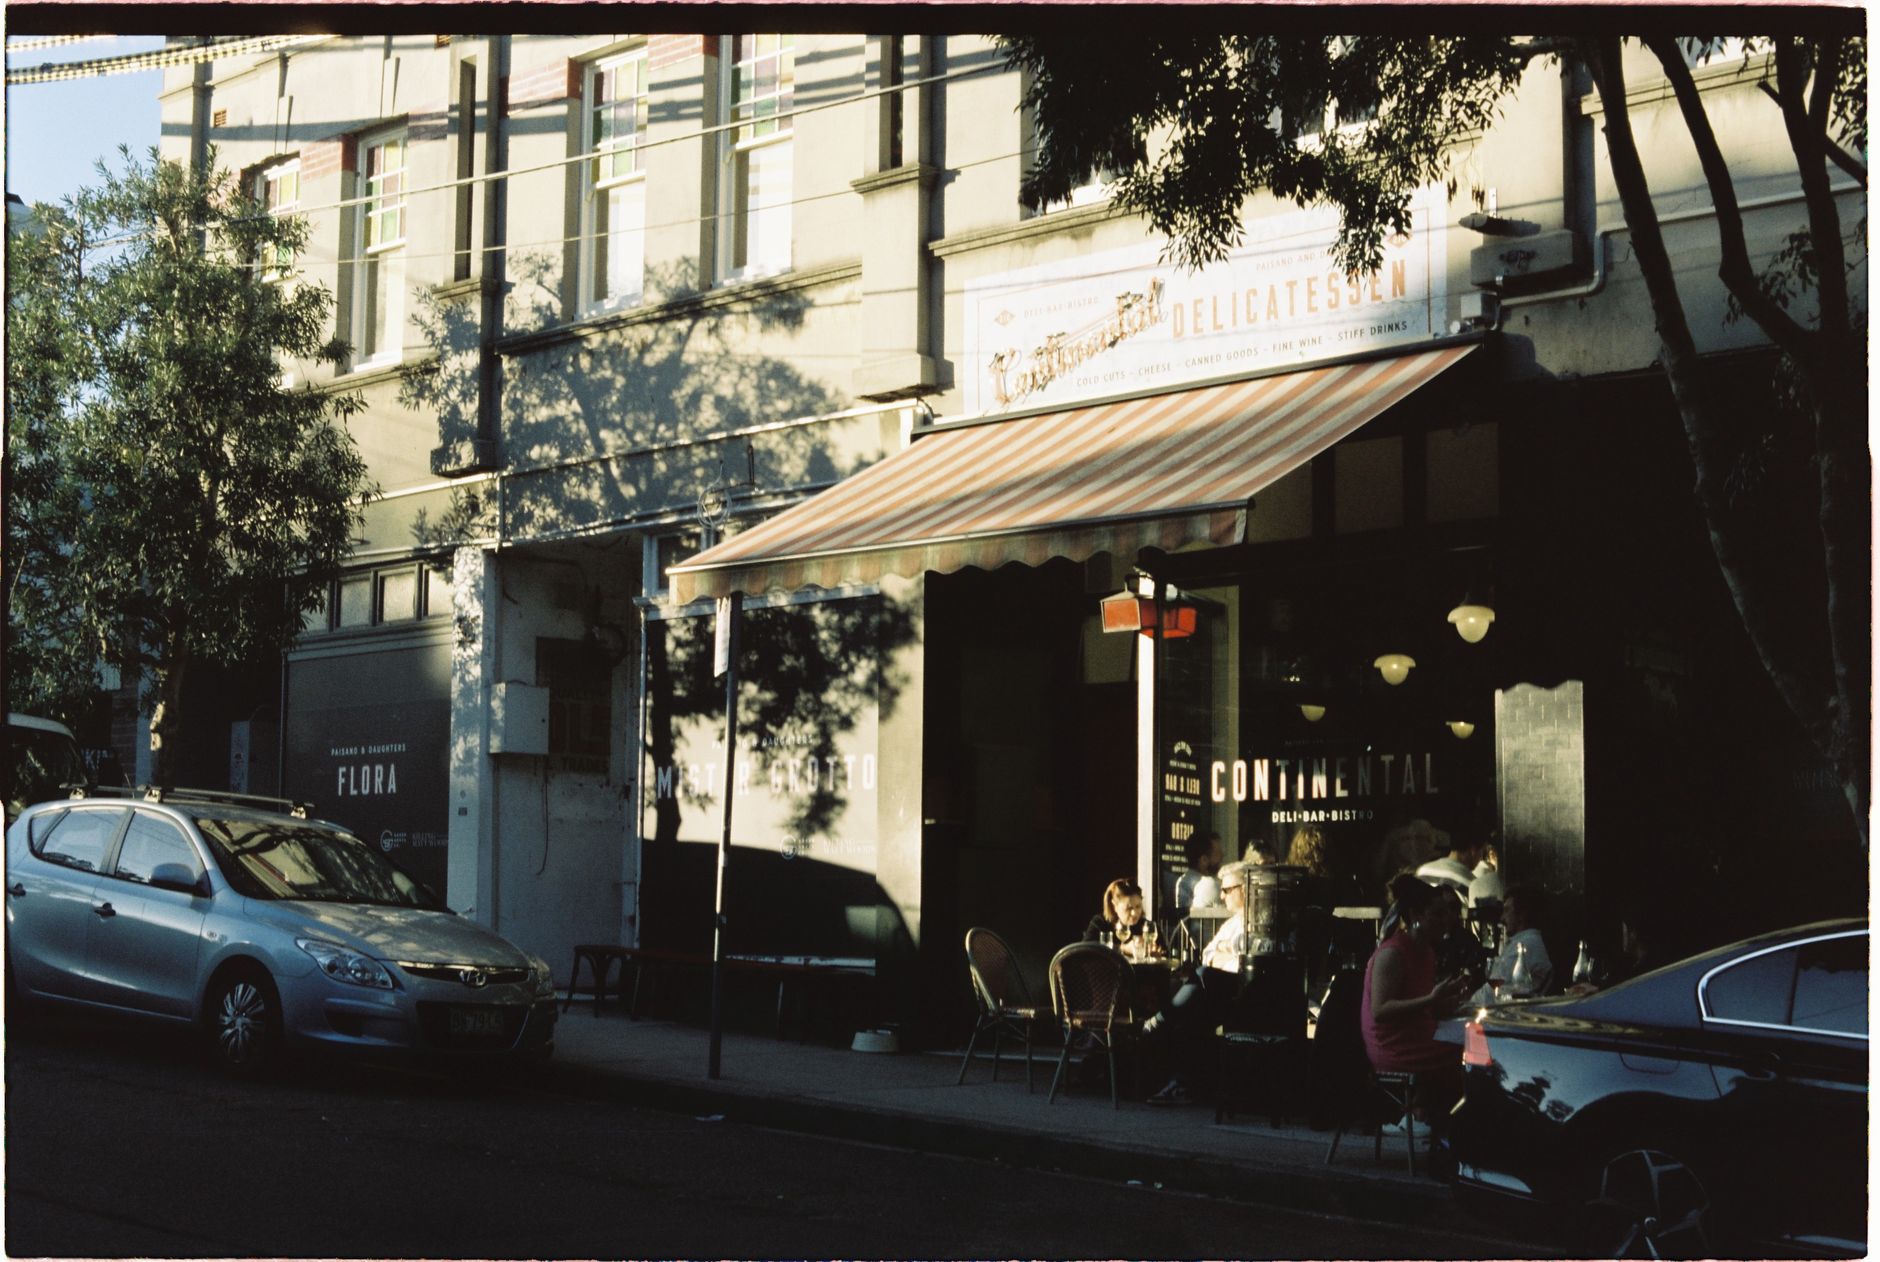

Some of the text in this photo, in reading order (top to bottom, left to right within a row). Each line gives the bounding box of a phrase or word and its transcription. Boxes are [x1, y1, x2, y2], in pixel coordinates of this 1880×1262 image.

[1172, 259, 1406, 338] DELICATESSEN
[1076, 320, 1408, 387] COLD CUTS CHEESE CANNED GOODS FINE WINE STIFF DRINKS
[330, 747, 358, 756] PAISANO
[368, 743, 406, 754] DAUGHTERS
[337, 762, 397, 797] FLORA
[657, 761, 750, 799] MISTR
[1210, 752, 1439, 803] CONTINENTAL
